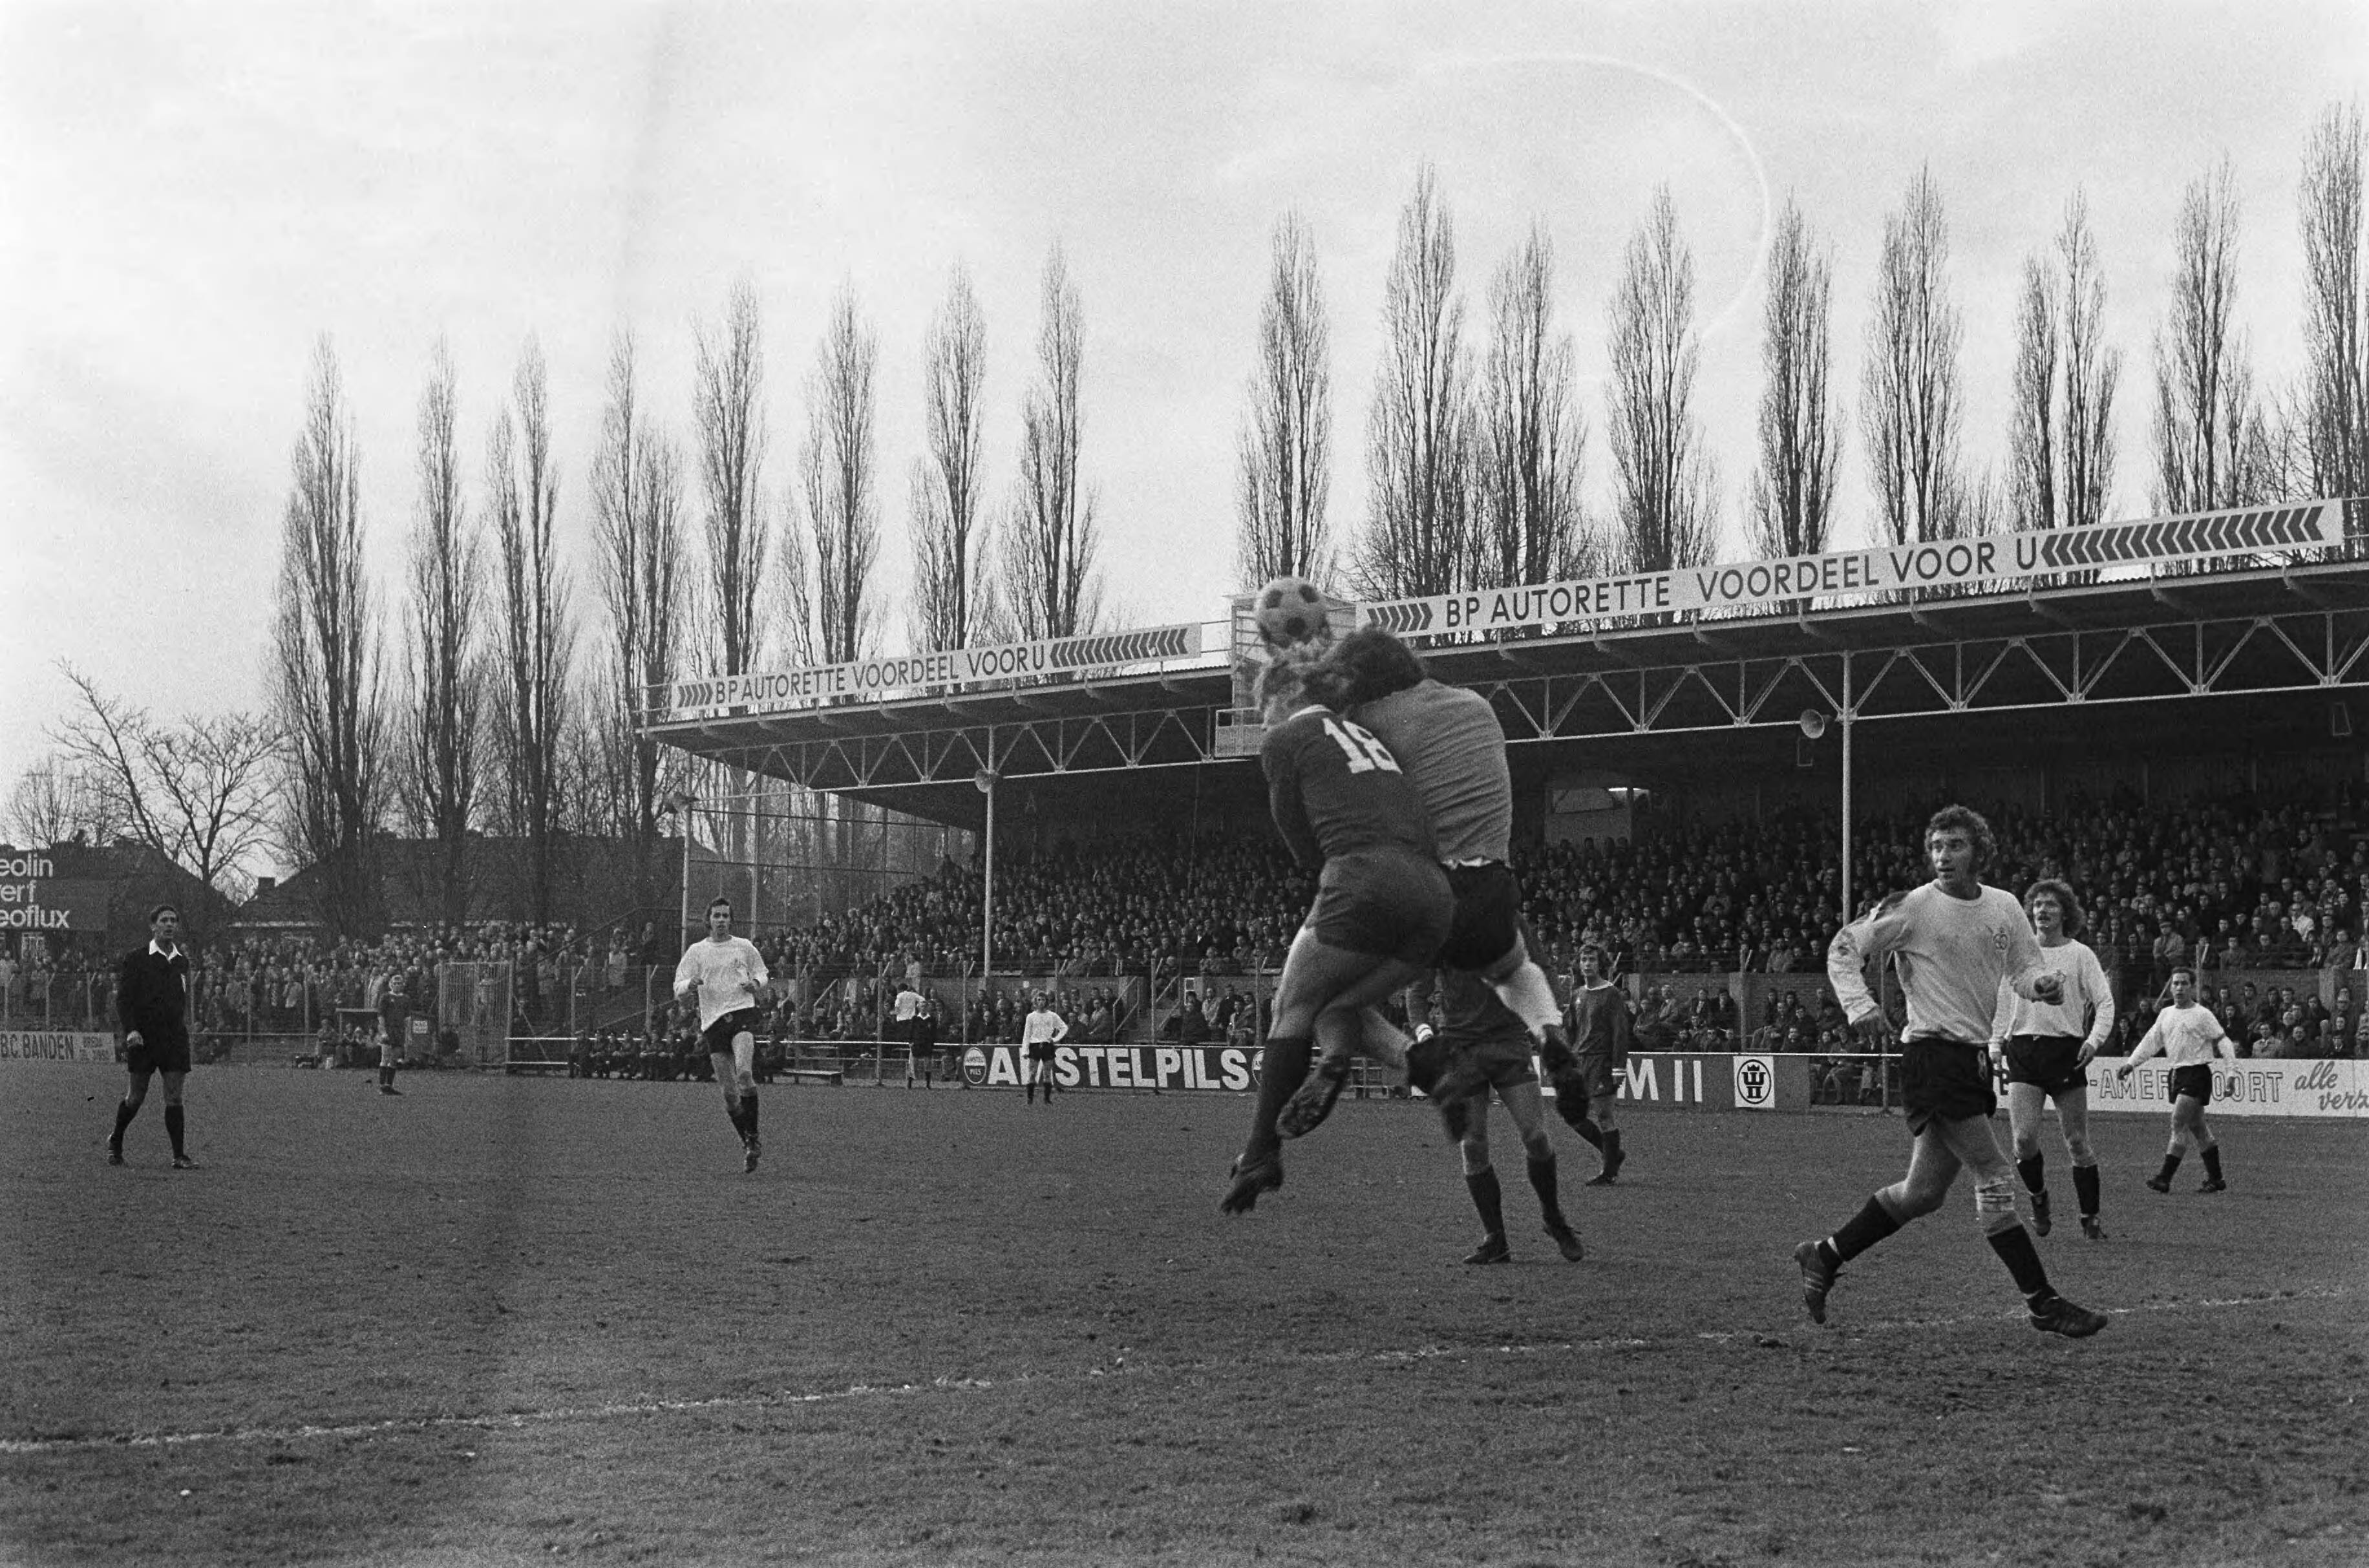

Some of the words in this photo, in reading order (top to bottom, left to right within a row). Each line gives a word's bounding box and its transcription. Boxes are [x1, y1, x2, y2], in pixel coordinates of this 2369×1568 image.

[1447, 597, 1480, 628] BP
[1491, 576, 1670, 623] AUTORETTE
[1697, 555, 1880, 602] VOORDEEL
[1890, 542, 1996, 582] VOOR
[2017, 537, 2036, 570] U
[716, 681, 738, 704] BP
[741, 667, 845, 701] AUTORETTE
[852, 654, 960, 689] VOORDEEL
[967, 647, 1028, 677] VOOR
[1034, 645, 1045, 670] U
[0, 880, 37, 903] erf
[23, 1033, 74, 1060] BANDEN
[2295, 1061, 2339, 1090] alle
